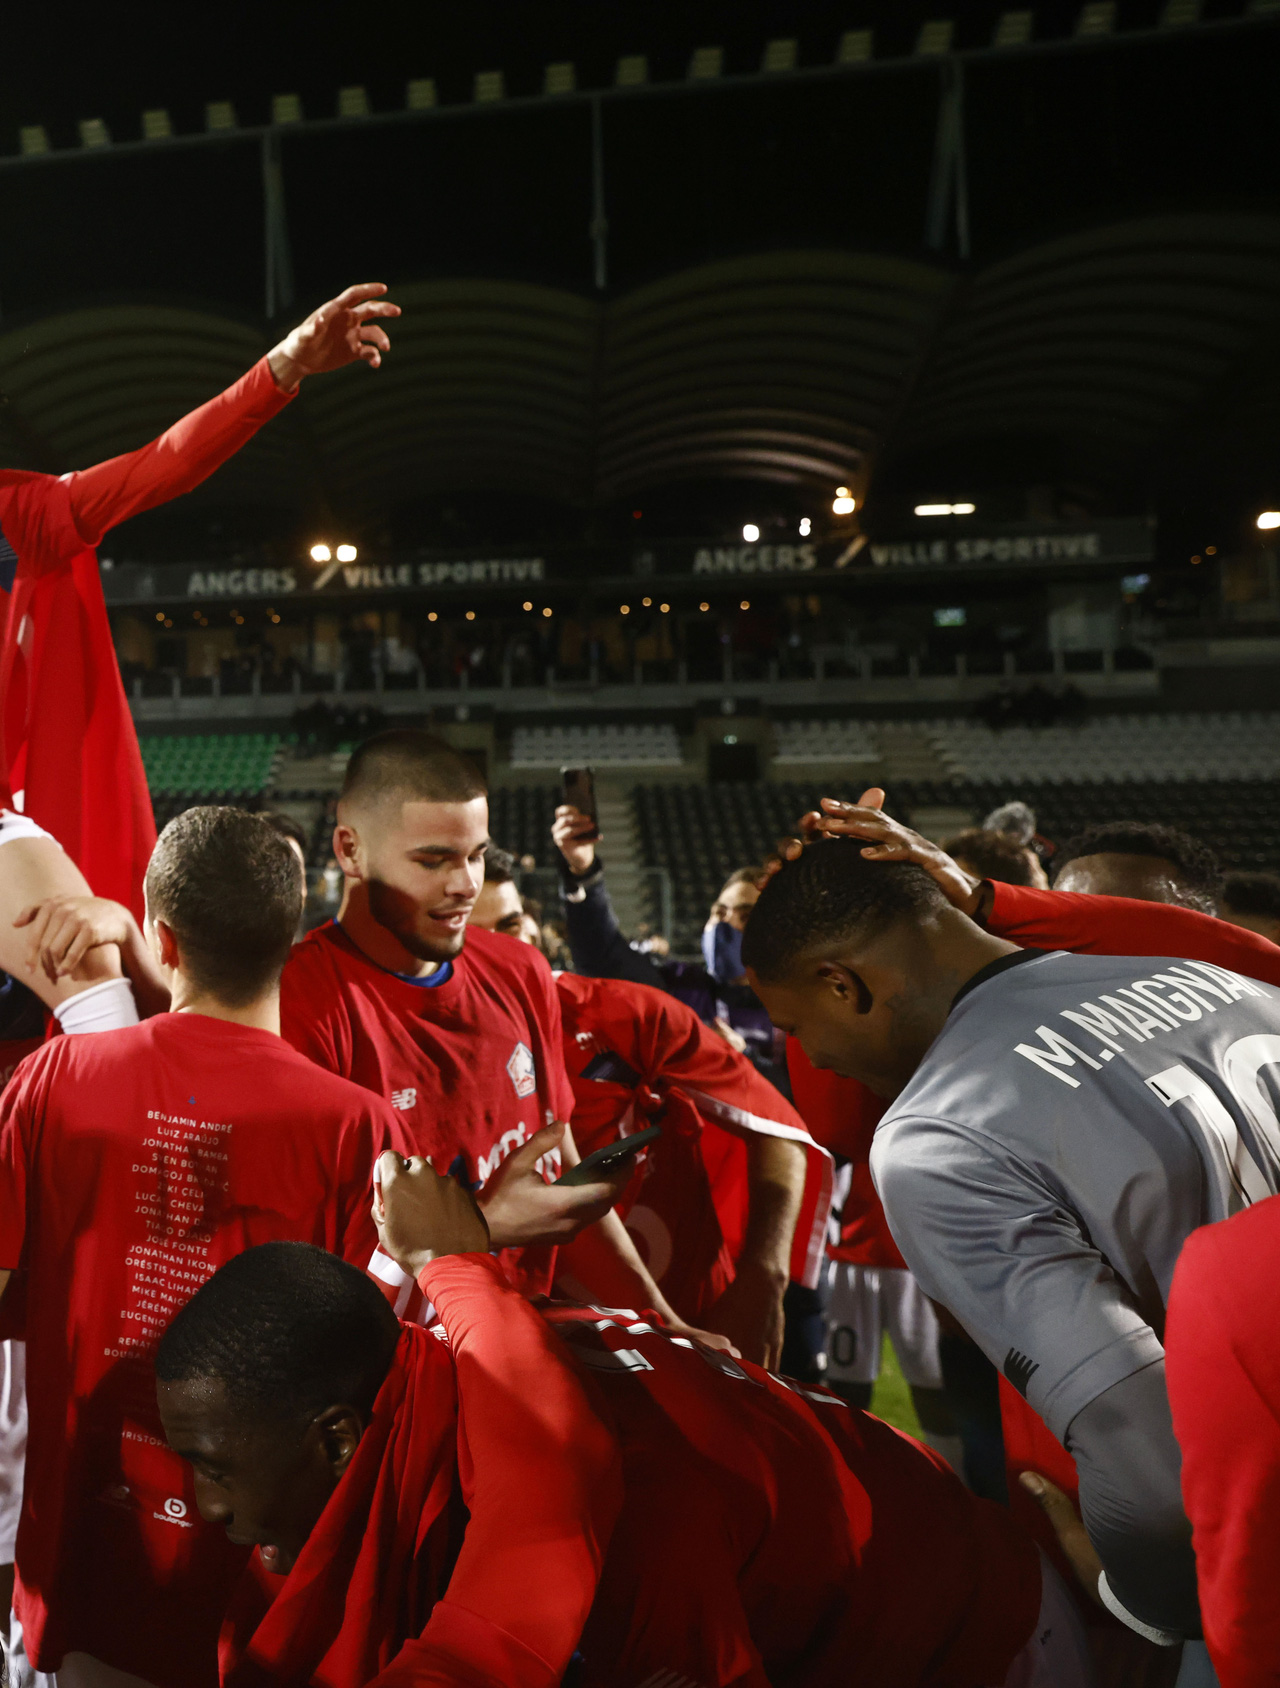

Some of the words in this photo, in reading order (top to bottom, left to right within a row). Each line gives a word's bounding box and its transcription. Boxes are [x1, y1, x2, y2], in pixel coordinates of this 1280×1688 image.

[693, 543, 817, 574] ANGERS
[869, 540, 946, 567] VILLE
[955, 534, 1100, 561] SPORTIVE
[187, 568, 296, 597] ANGERS
[342, 563, 413, 589] VILLE
[418, 558, 545, 585] SPORTIVE
[147, 1110, 197, 1128] BENJAMIN
[199, 1121, 233, 1134] ANDRÉ
[157, 1126, 181, 1139] LUIZ
[142, 1138, 193, 1154] JONATHA
[135, 1191, 163, 1204] LUCA
[157, 1181, 178, 1194] ZKI
[181, 1187, 205, 1199] ÇELI
[135, 1205, 190, 1224] JONAHAN
[129, 1244, 184, 1265] JONATHAN
[171, 1241, 208, 1257] FONTE
[124, 1257, 168, 1274] ORÉSTIS
[131, 1284, 158, 1299] MIKE
[134, 1272, 166, 1287] ISAAC
[167, 1281, 200, 1297] LIHAD
[120, 1309, 167, 1328] EUGENIO
[117, 1336, 152, 1349] RENAT
[153, 1511, 195, 1528] boulanger
